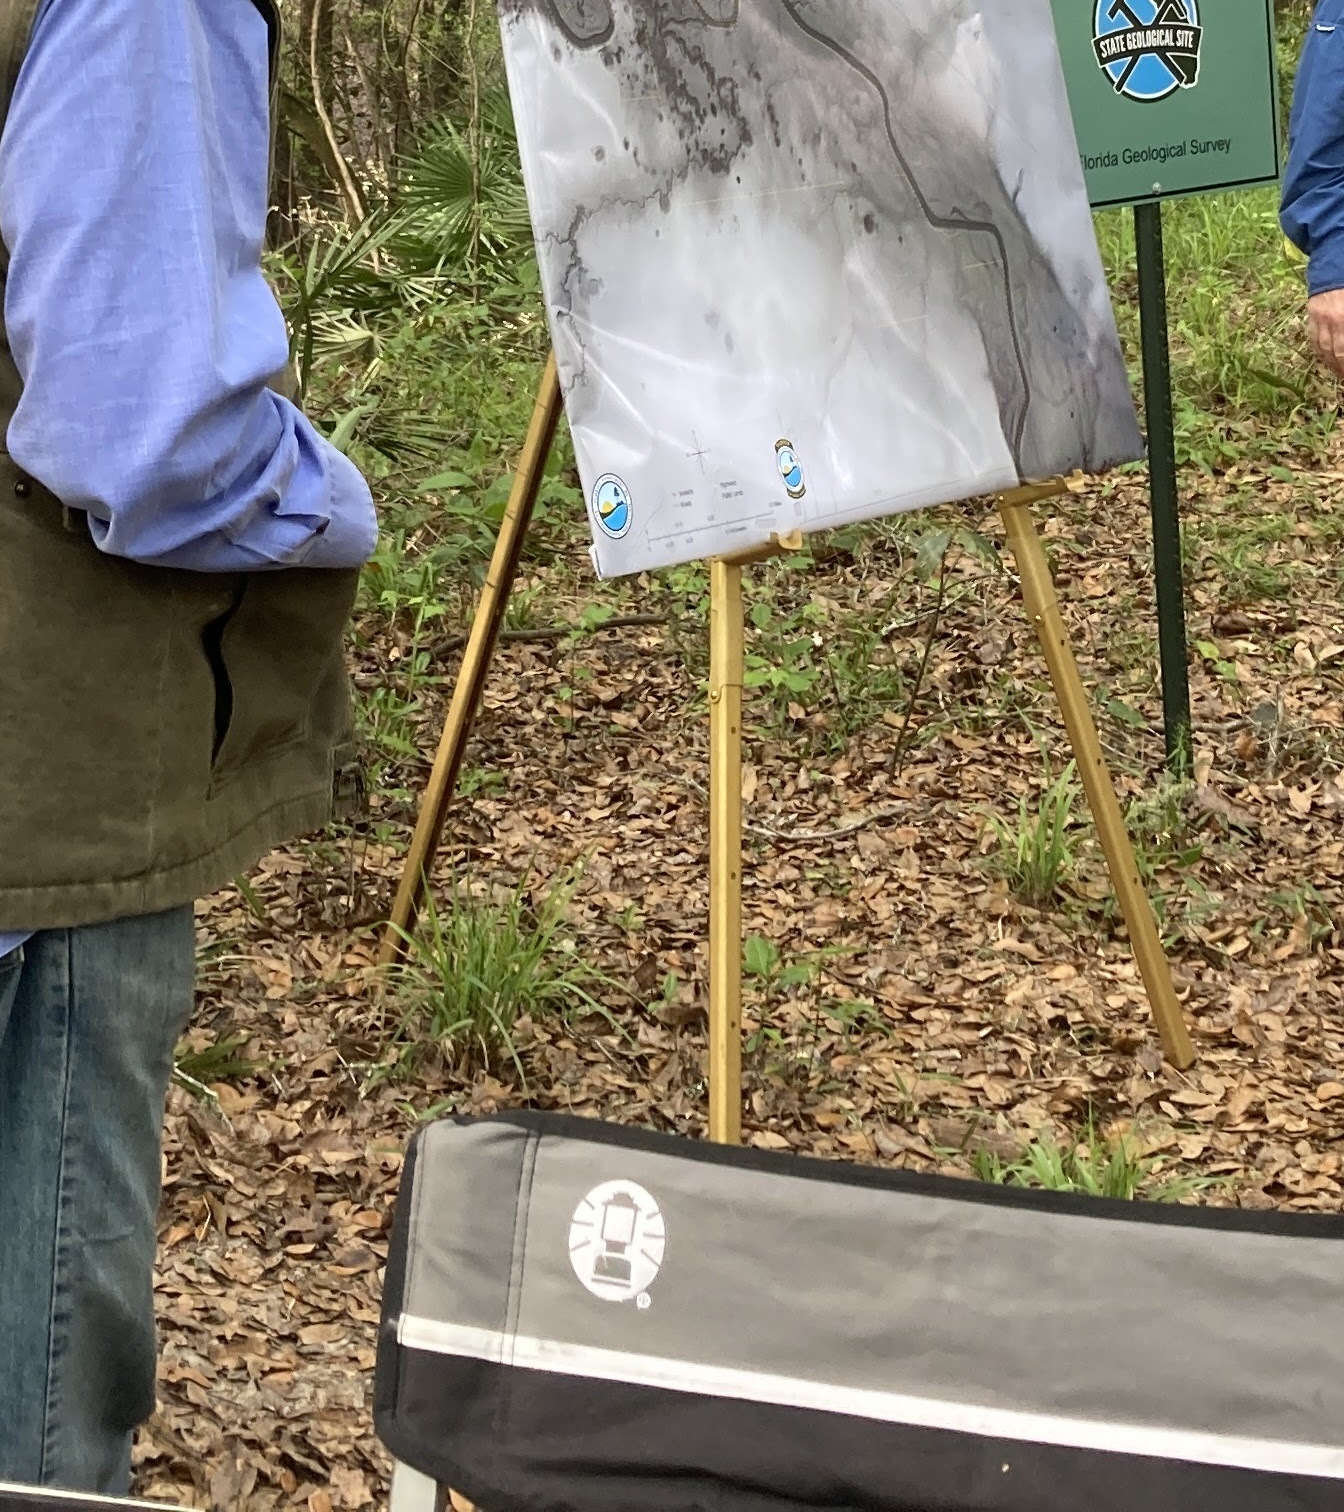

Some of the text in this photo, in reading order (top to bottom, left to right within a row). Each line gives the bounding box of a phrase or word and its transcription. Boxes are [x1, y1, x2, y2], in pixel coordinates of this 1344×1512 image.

[1099, 29, 1195, 58] STATE GEOLOGICAL SITE
[1122, 141, 1187, 165] Geological
[1190, 136, 1231, 157] Survey
